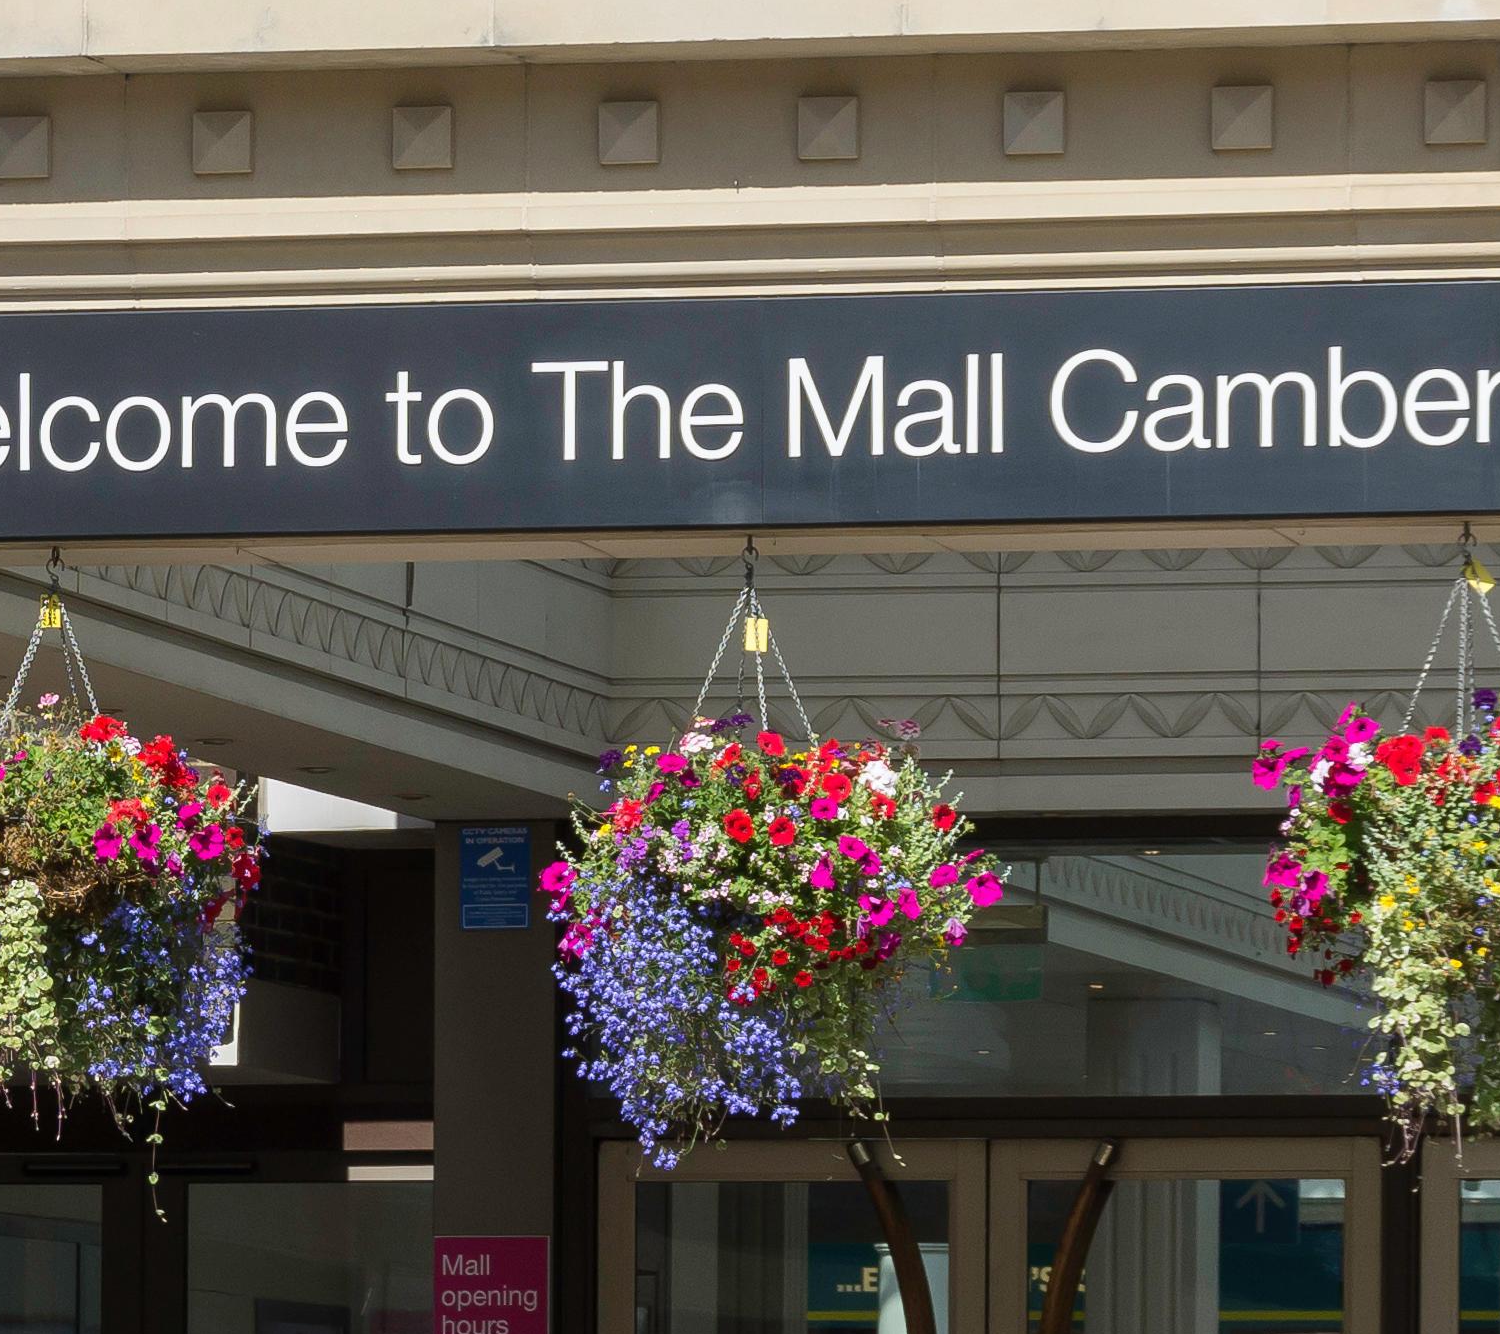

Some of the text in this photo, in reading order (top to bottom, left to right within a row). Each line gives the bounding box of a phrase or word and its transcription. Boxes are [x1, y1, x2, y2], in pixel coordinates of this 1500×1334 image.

[387, 370, 494, 467] to
[531, 360, 744, 463] The
[788, 352, 1003, 458] Mall
[488, 827, 527, 835] CAMERAS
[442, 1254, 490, 1276] Mall
[441, 1285, 538, 1312] opening
